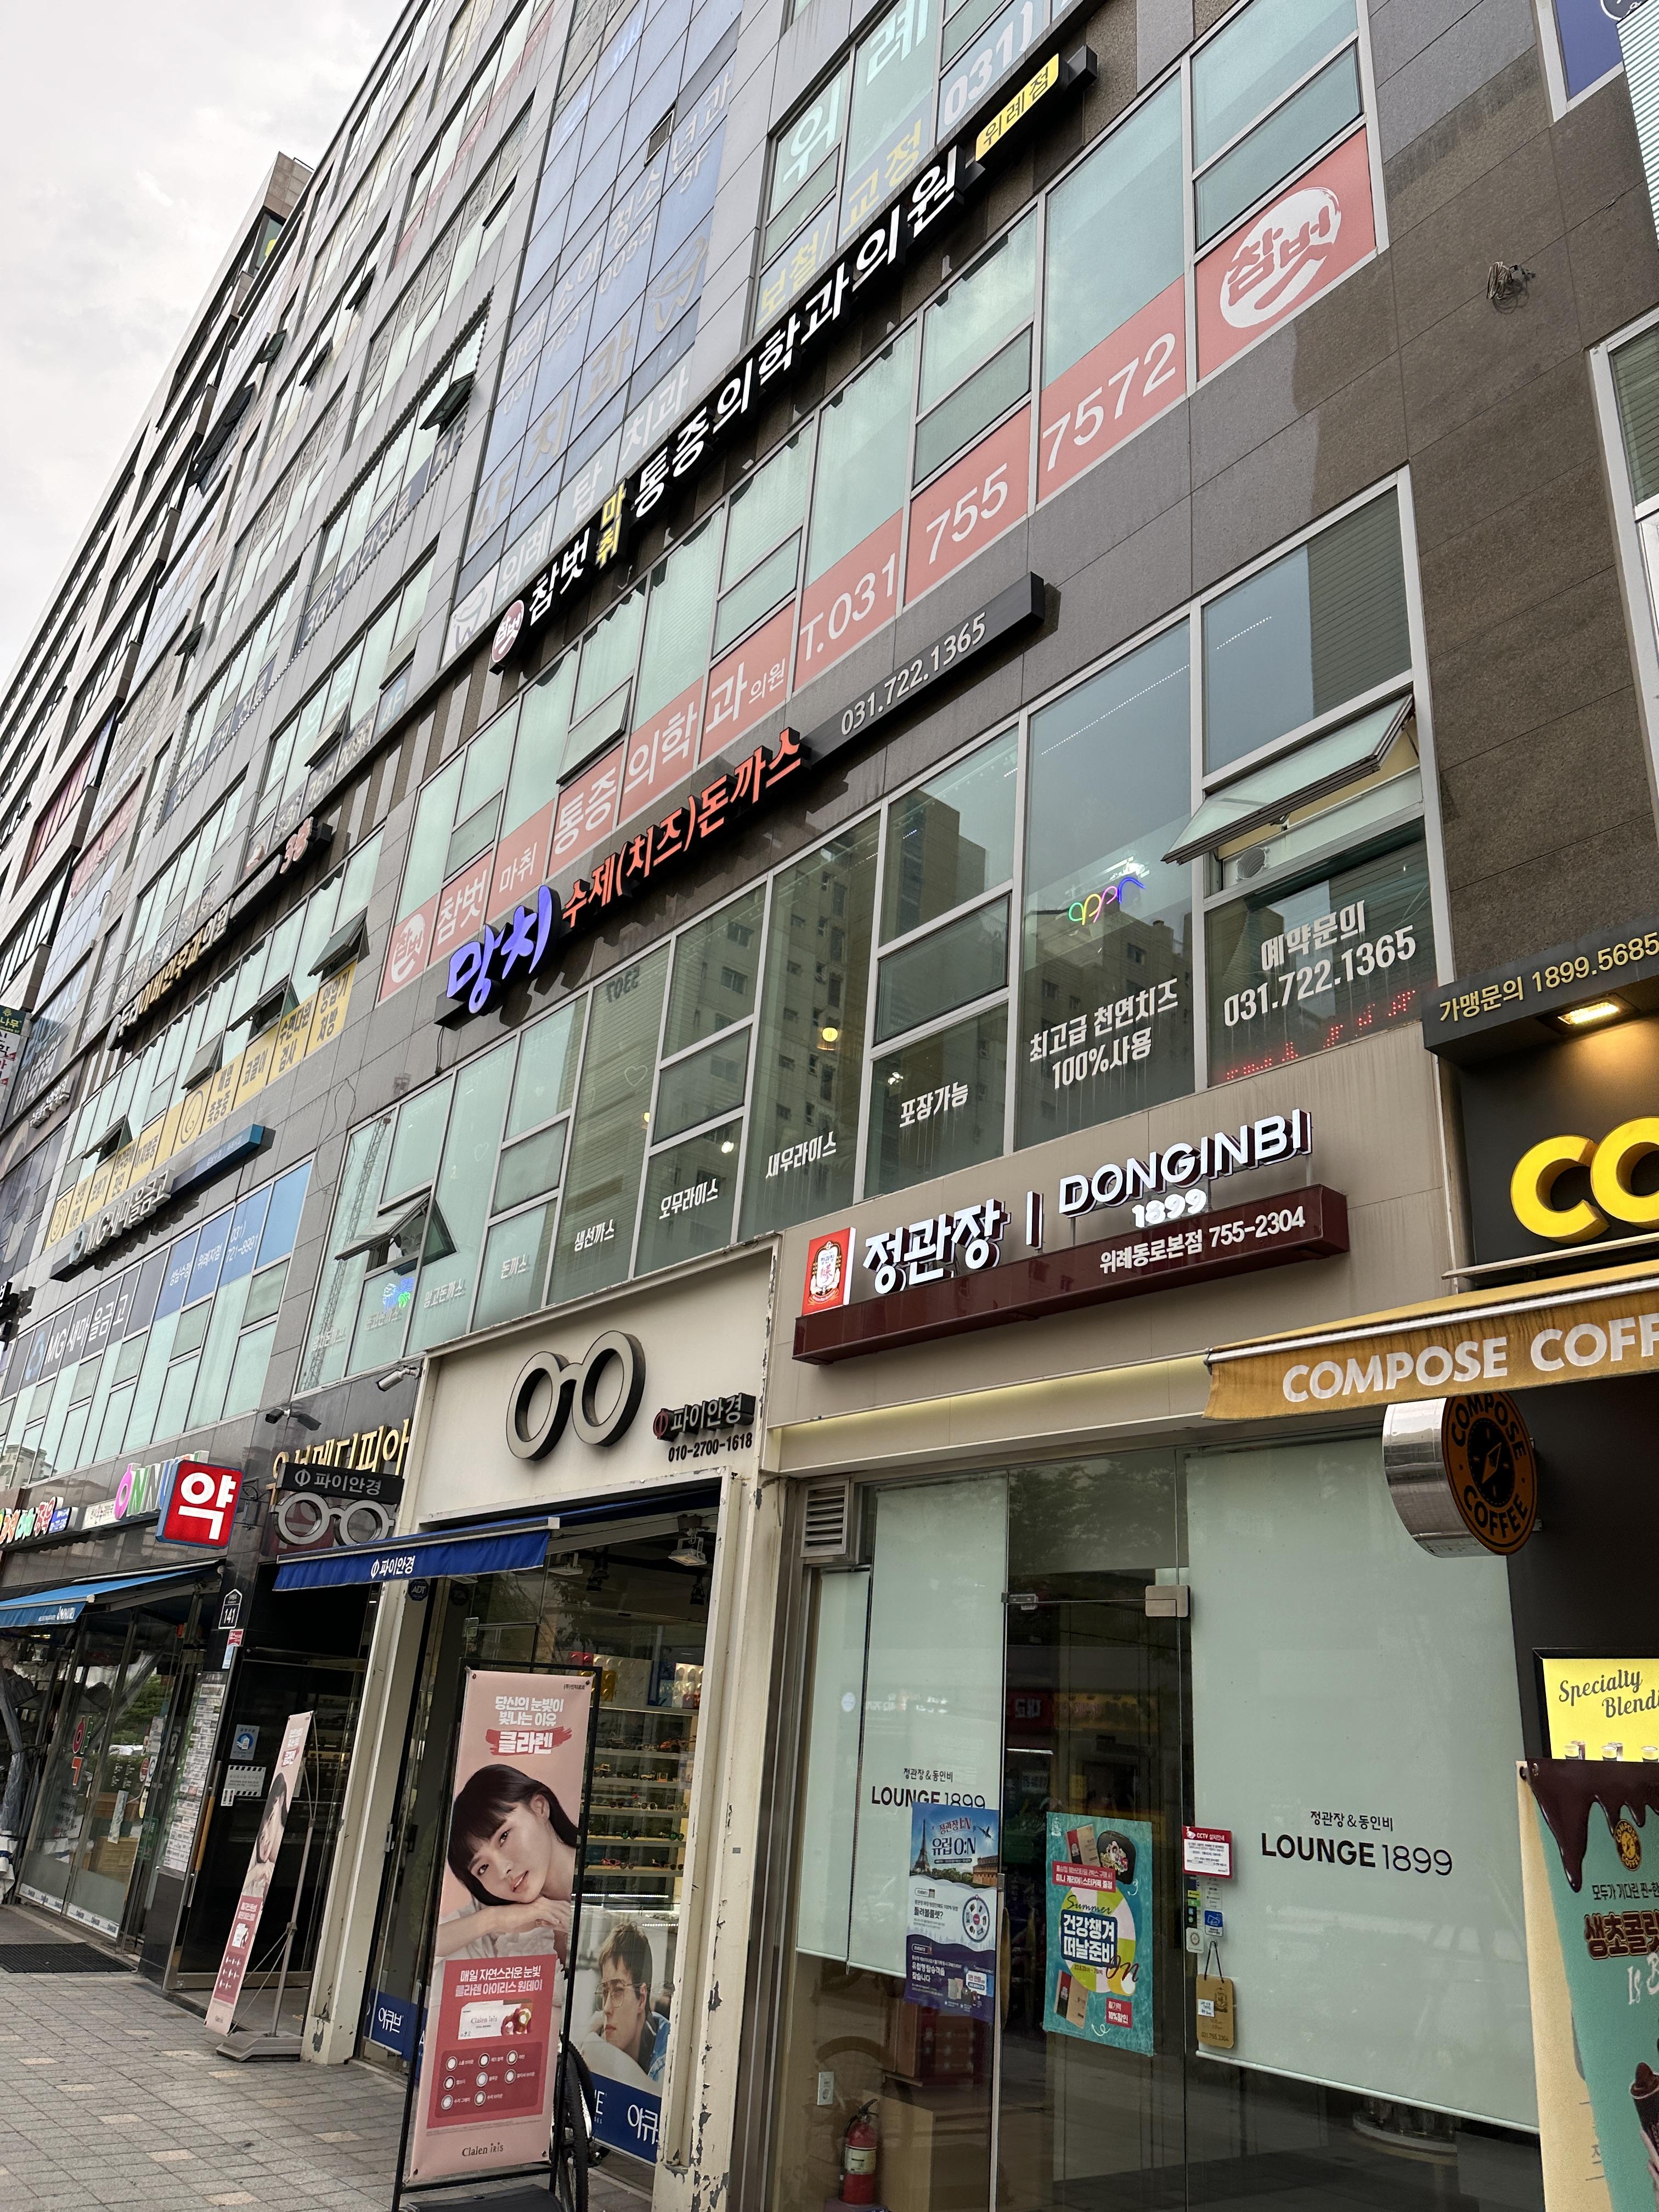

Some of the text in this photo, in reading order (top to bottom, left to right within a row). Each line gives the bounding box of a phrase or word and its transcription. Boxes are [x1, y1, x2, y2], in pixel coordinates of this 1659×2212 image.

[680, 138, 710, 192] 5F
[843, 118, 921, 236] 교정
[529, 66, 1050, 625] 참벗 마취 통증의학과의원 위례점
[523, 316, 634, 478] 치과
[622, 367, 689, 460] 치과
[436, 867, 486, 946] 참벗
[498, 842, 538, 893] 마취
[749, 659, 786, 705] 의원
[926, 462, 1008, 565] 755
[1041, 332, 1176, 472] 7572
[381, 684, 405, 727] 4F
[562, 727, 801, 927] 수제(치즈)돈까스
[841, 612, 987, 735] 031.722.1365
[1261, 900, 1367, 971] 예약문의
[1224, 925, 1417, 1027] 031.722.1365
[1438, 931, 1659, 1024] 가맹문의 1899.5685
[1030, 1014, 1087, 1063] 최고급
[1094, 978, 1178, 1036] 천연치즈
[242, 1048, 268, 1086] 코골이
[279, 1039, 297, 1073] 검사
[1052, 1027, 1152, 1090] 100%사용
[899, 1082, 968, 1128] 포장가능
[766, 1132, 836, 1179] 새우라이스
[659, 1178, 718, 1220] 오무라이스
[863, 1109, 1310, 1294] 정관장 DONGINBI
[1131, 1188, 1206, 1228] 1899
[574, 1218, 614, 1252] 생선까스
[1100, 1206, 1306, 1274] 위례동로본점 755-2304
[198, 1243, 222, 1270] 위례지점
[500, 1254, 528, 1279] 돈까스
[1282, 1313, 1659, 1404] COMPOSE COFF
[670, 1393, 742, 1431] 파이안경
[1452, 1393, 1527, 1461] COMPOSE
[668, 1432, 752, 1462] 010-2700-1618
[314, 1472, 381, 1495] 파이안경
[178, 1472, 236, 1540] 약
[1464, 1485, 1528, 1538] COFFEE
[379, 1556, 415, 1576] 파이안경
[411, 1584, 426, 1595] ADT
[224, 1608, 235, 1624] 141
[495, 1696, 564, 1713] 당신의 눈빛이
[1559, 1669, 1643, 1706] Specialty
[1602, 1689, 1659, 1718] Blend
[499, 1711, 557, 1726] 빛나는 이유
[498, 1731, 554, 1754] 클라렌
[872, 1786, 941, 1807] LOUNGE
[932, 1837, 952, 1855] 유럽
[940, 1820, 958, 1835] 정관장
[1261, 1833, 1375, 1867] LOUNGE
[1381, 1844, 1453, 1876] 1899
[1066, 1894, 1111, 1914] Summer
[1592, 1884, 1616, 1900] 모두가
[1618, 1883, 1639, 1899] 기다린
[1063, 1914, 1115, 1942] 건강챙겨
[1063, 1936, 1114, 1963] 떠날준비
[455, 1979, 543, 1997] 클라렌 아이리스 원데이
[460, 1965, 541, 1982] 매일 자연스러운 눈빛
[379, 2007, 402, 2033] 아큐브
[628, 2104, 658, 2145] 아큐
[462, 2147, 488, 2157] Clalen
